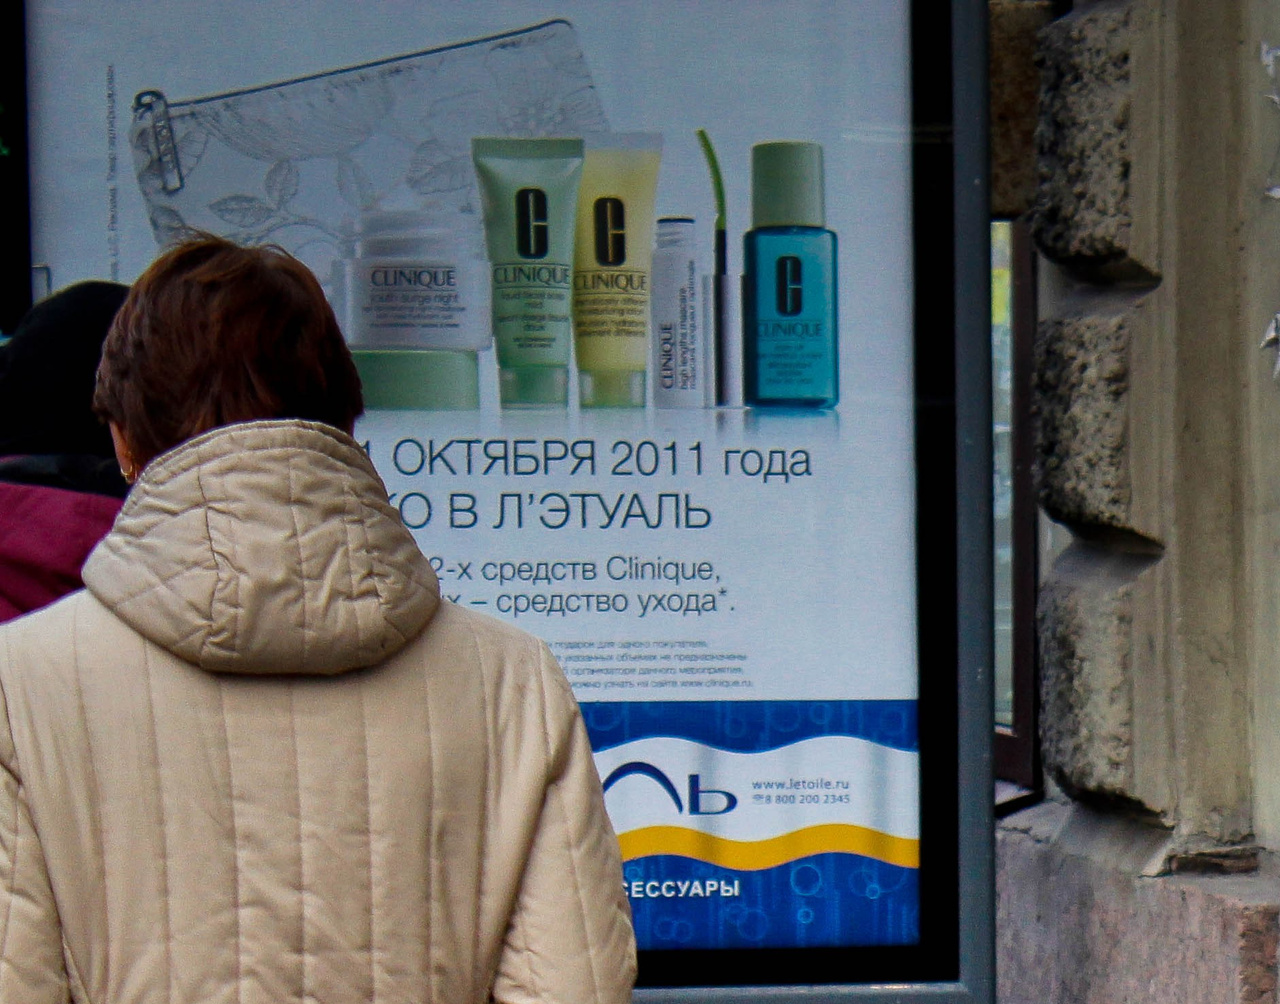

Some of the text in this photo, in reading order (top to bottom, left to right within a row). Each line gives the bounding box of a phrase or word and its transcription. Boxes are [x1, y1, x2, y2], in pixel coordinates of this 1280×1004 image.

[371, 269, 457, 289] CLINIQUE
[494, 266, 570, 286] CLINIQUE
[573, 272, 648, 292] CLINIQUE
[661, 323, 674, 391] CLINIQUE
[393, 438, 595, 476] ОКТЯБРЯ
[611, 440, 702, 476] 2011
[725, 449, 812, 484] года
[450, 493, 478, 528] В
[482, 562, 597, 584] средств
[606, 555, 720, 586] Clinique,
[497, 593, 628, 616] средство
[752, 778, 850, 790] www.letoile.ru
[775, 794, 796, 804] 800
[799, 794, 819, 804] 200
[823, 794, 850, 804] 2345
